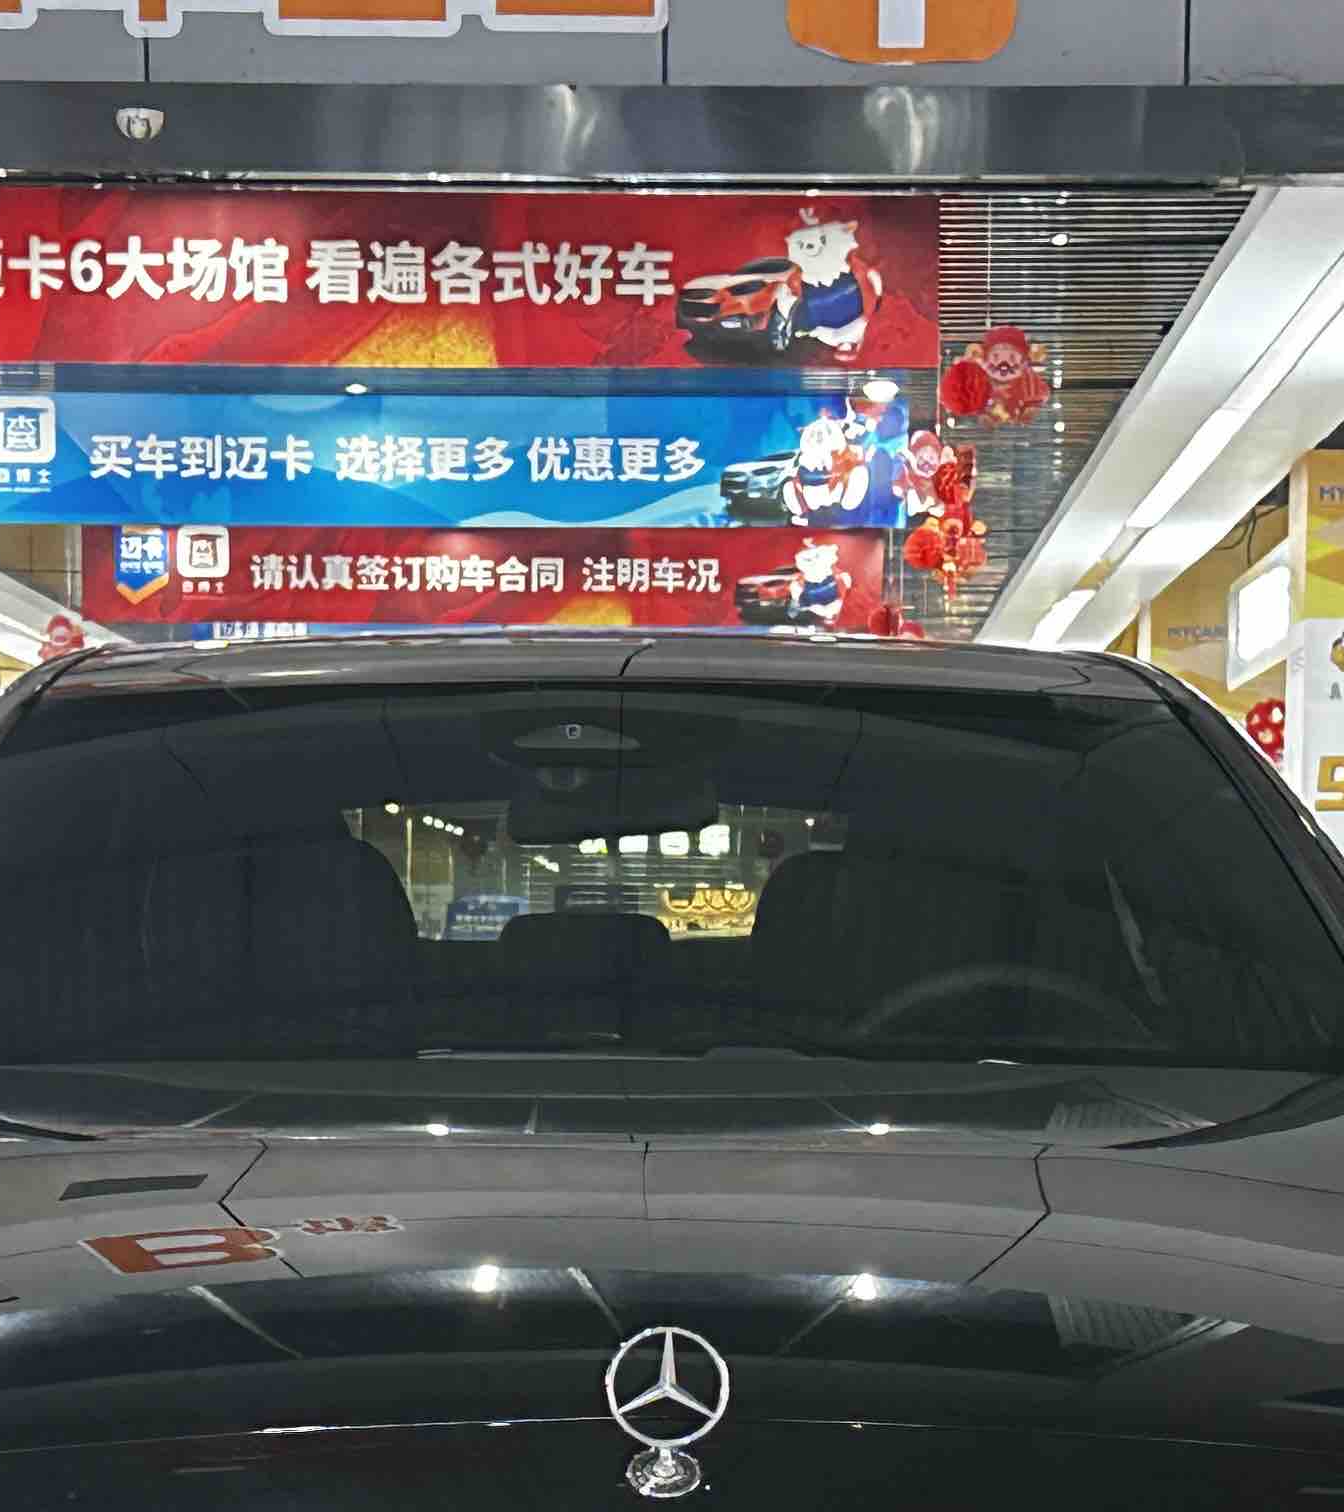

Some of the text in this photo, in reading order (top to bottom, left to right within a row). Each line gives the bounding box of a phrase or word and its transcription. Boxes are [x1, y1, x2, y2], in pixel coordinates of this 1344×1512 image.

[304, 240, 677, 306] 看遍各式好车
[88, 434, 708, 483] 买车到迈卡 选择更多 优惠更多
[249, 554, 722, 593] 请认真签订购车合同 注明车况
